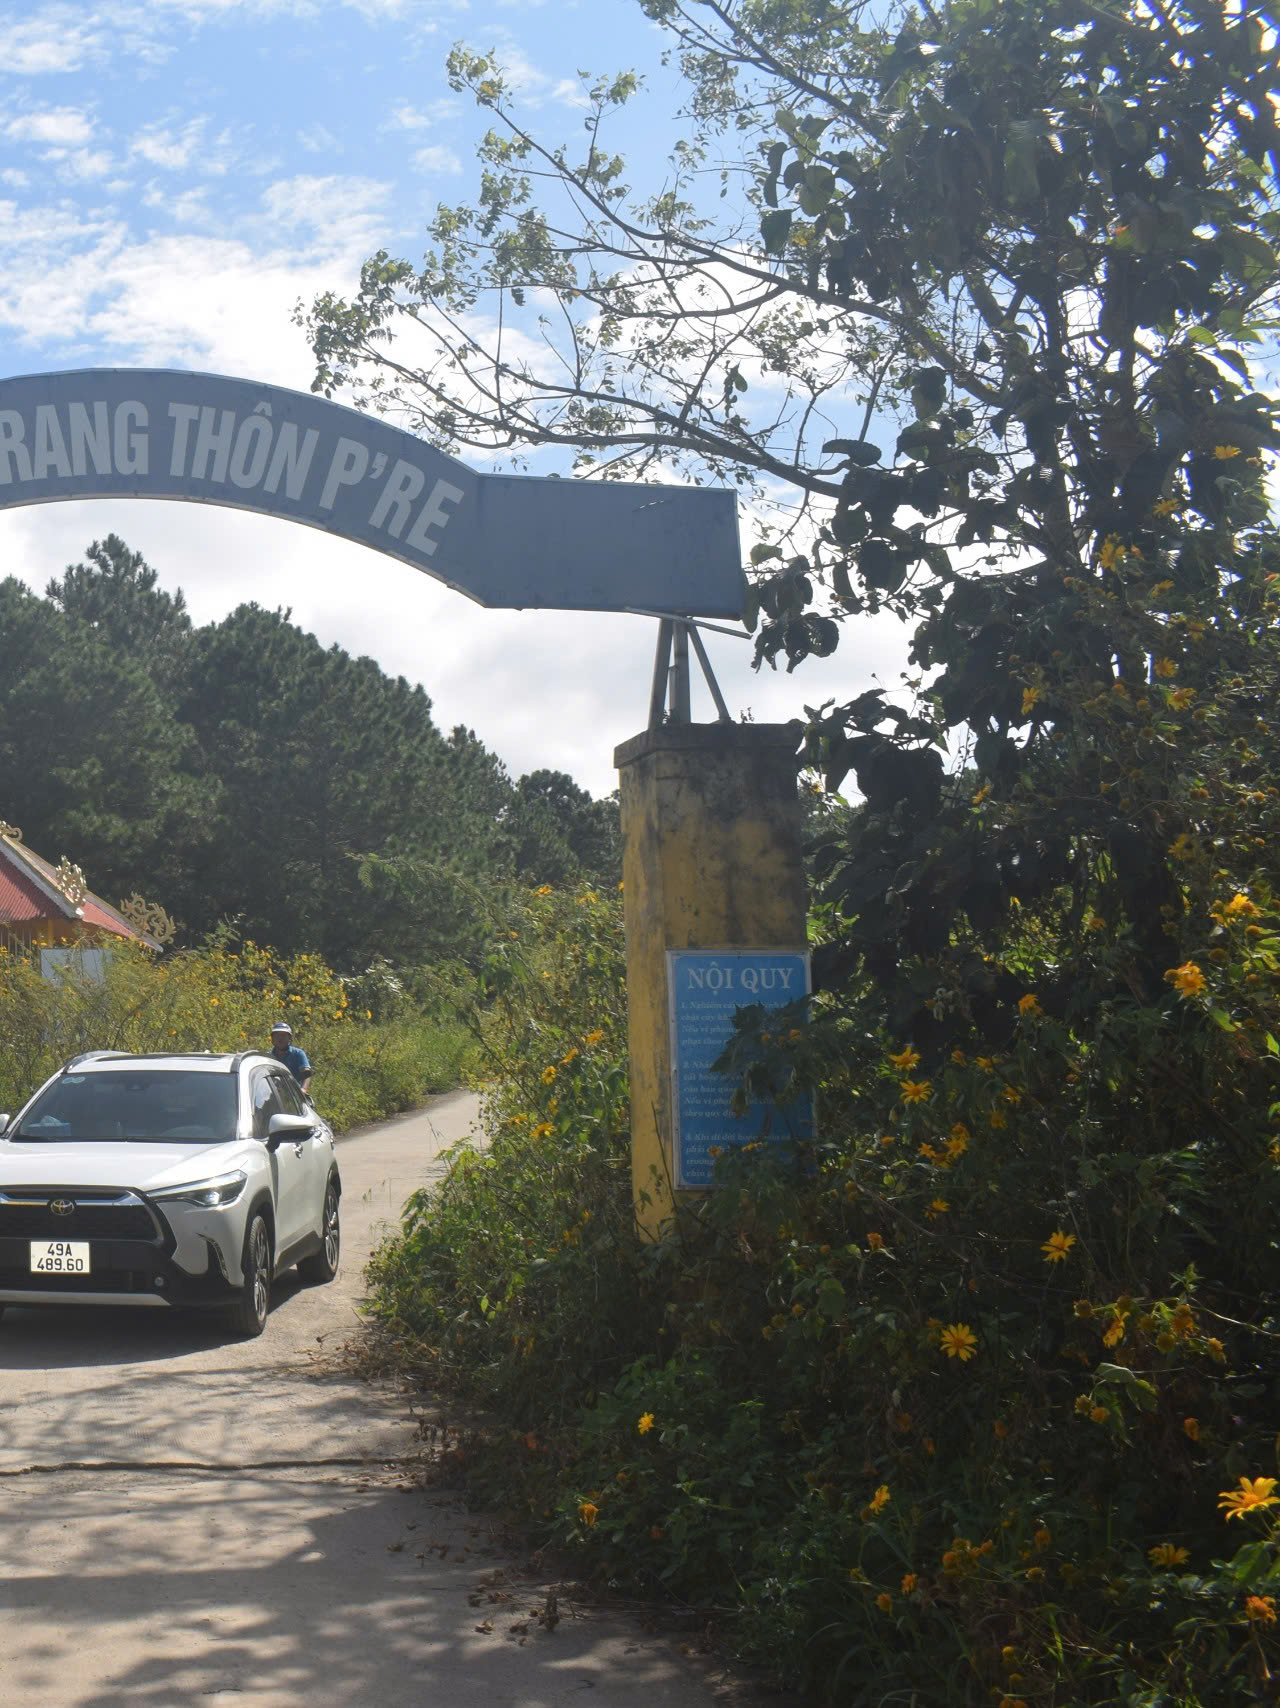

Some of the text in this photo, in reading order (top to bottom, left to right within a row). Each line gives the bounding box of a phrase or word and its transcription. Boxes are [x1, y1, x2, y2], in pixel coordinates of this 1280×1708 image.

[168, 401, 320, 500] THÔN
[687, 961, 793, 996] NỘI QUY
[47, 1243, 72, 1256] 49A
[37, 1258, 83, 1271] 489.60
